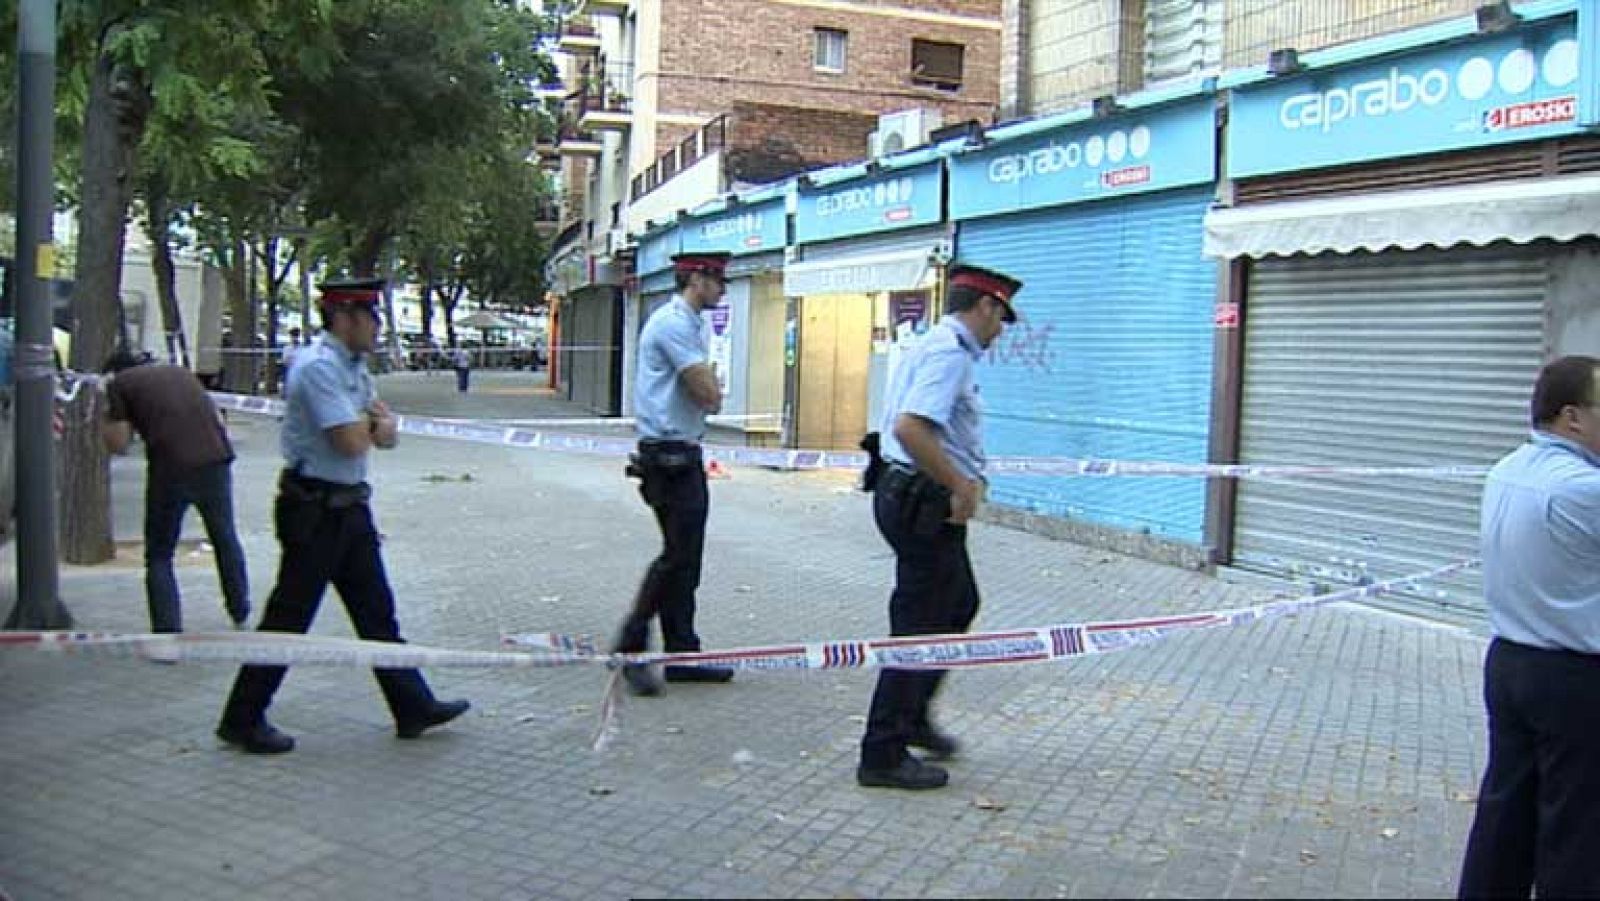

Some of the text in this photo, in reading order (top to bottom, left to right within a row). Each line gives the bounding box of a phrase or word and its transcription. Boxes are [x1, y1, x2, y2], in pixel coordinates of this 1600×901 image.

[1280, 67, 1449, 132] caprabo
[1510, 100, 1574, 126] EROSKI
[988, 139, 1081, 184] caprabo
